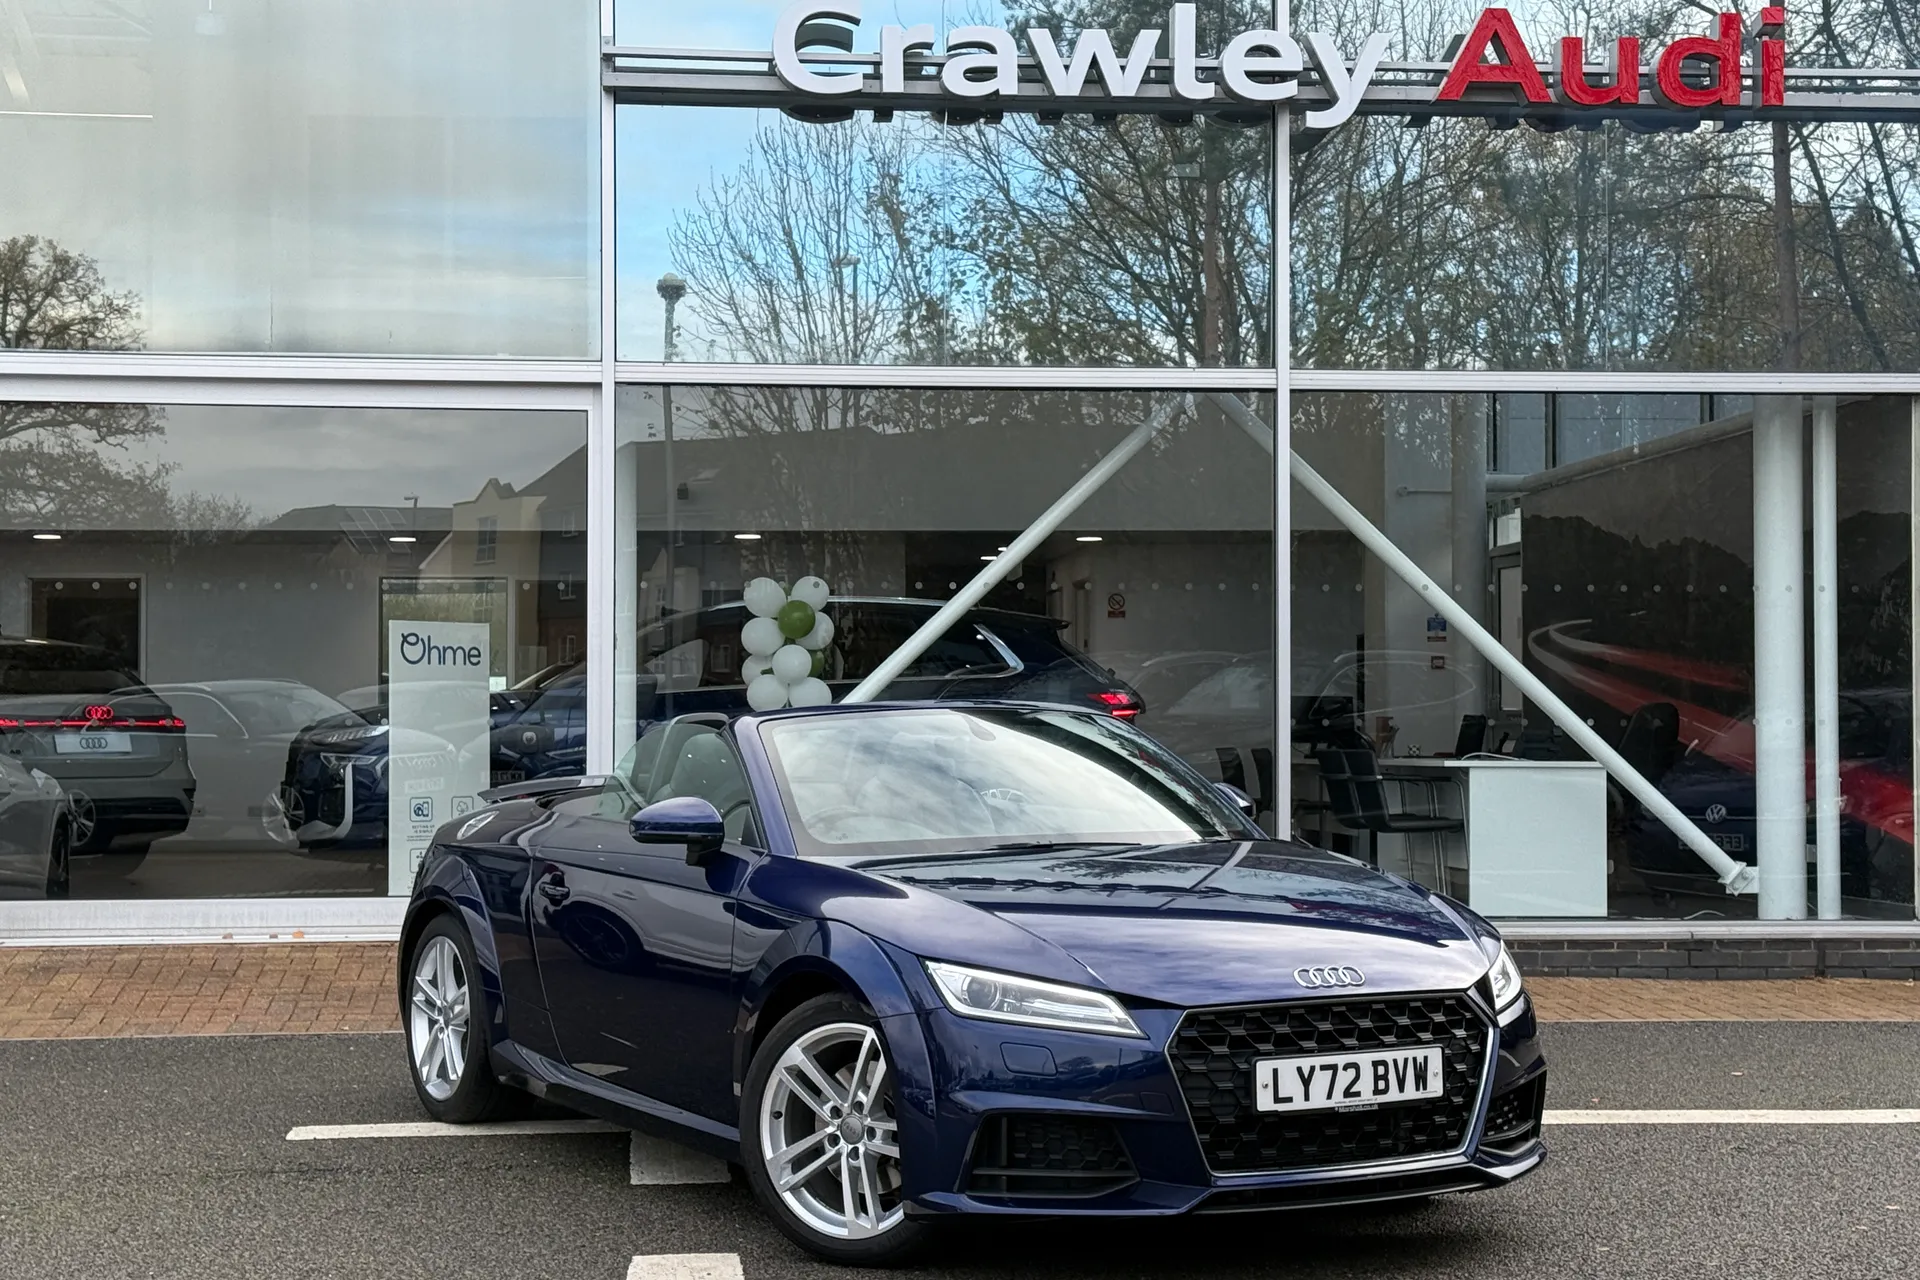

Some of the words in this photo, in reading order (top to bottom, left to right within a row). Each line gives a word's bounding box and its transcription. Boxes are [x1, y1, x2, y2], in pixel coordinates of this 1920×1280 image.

[773, 0, 1391, 129] Crawley
[1434, 6, 1785, 107] Audi
[400, 632, 482, 667] Ohme
[1272, 1061, 1362, 1105] LY72
[1371, 1055, 1429, 1096] BVW
